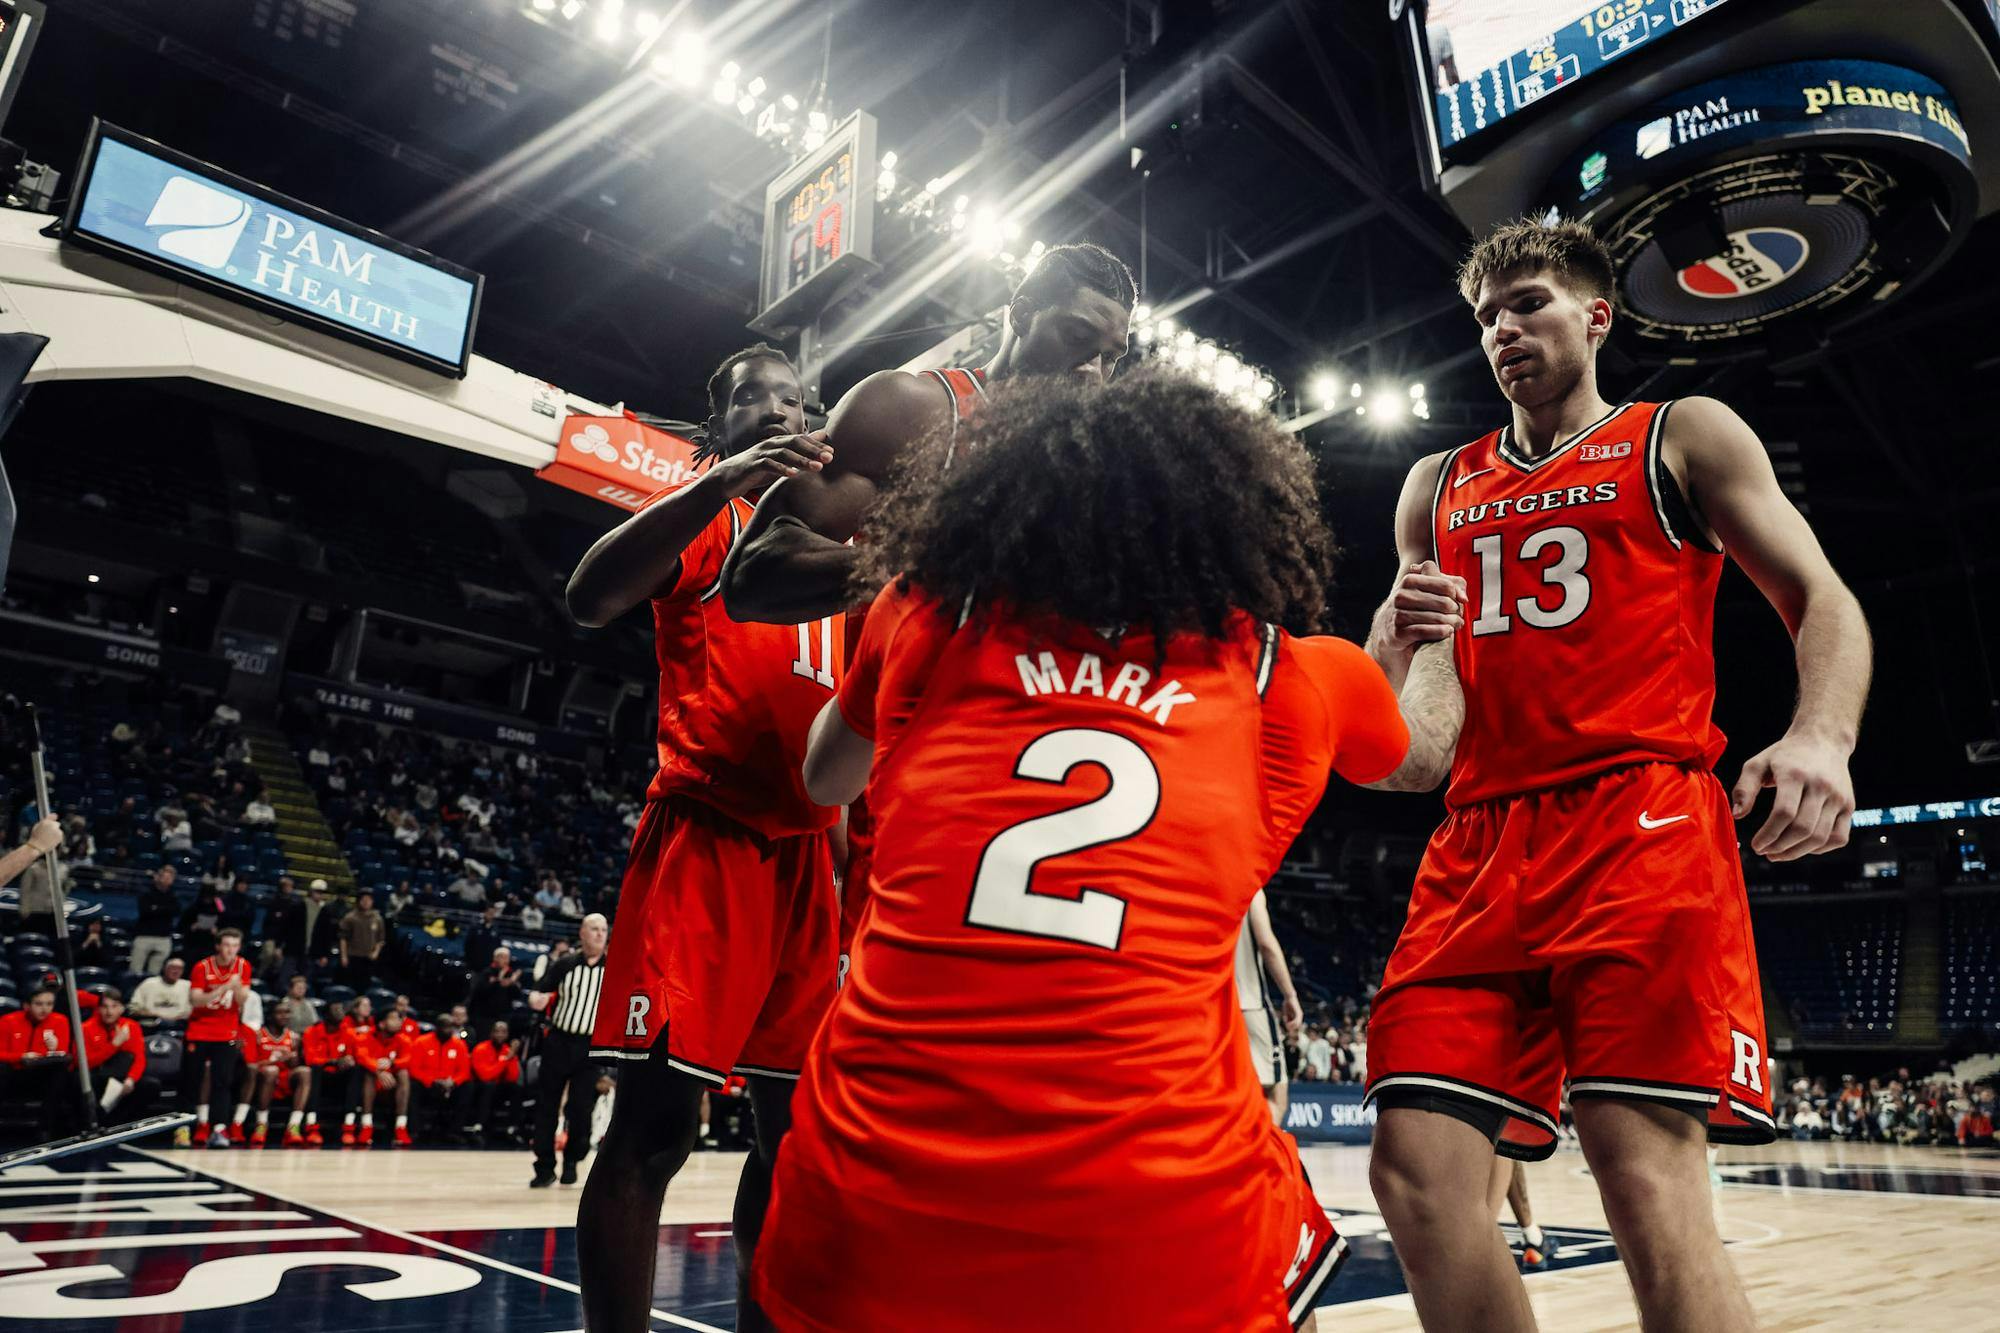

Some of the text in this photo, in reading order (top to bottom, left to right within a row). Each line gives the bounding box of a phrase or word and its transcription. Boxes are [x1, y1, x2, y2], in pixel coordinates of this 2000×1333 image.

[1580, 0, 1651, 37] 10:5
[1529, 46, 1558, 73] 45
[1675, 96, 1729, 127] PAM
[1803, 80, 1922, 115] planet
[260, 213, 377, 285] PAM
[1721, 238, 1772, 289] PEPS
[1448, 482, 1619, 531] RUTGERS
[1472, 526, 1592, 637] 13
[106, 646, 159, 668] SONG
[792, 616, 835, 692] 11
[1015, 652, 1197, 726] MARK
[497, 726, 536, 745] SONG
[963, 727, 1161, 951] 2
[625, 995, 651, 1036] R
[1731, 1029, 1764, 1094] R
